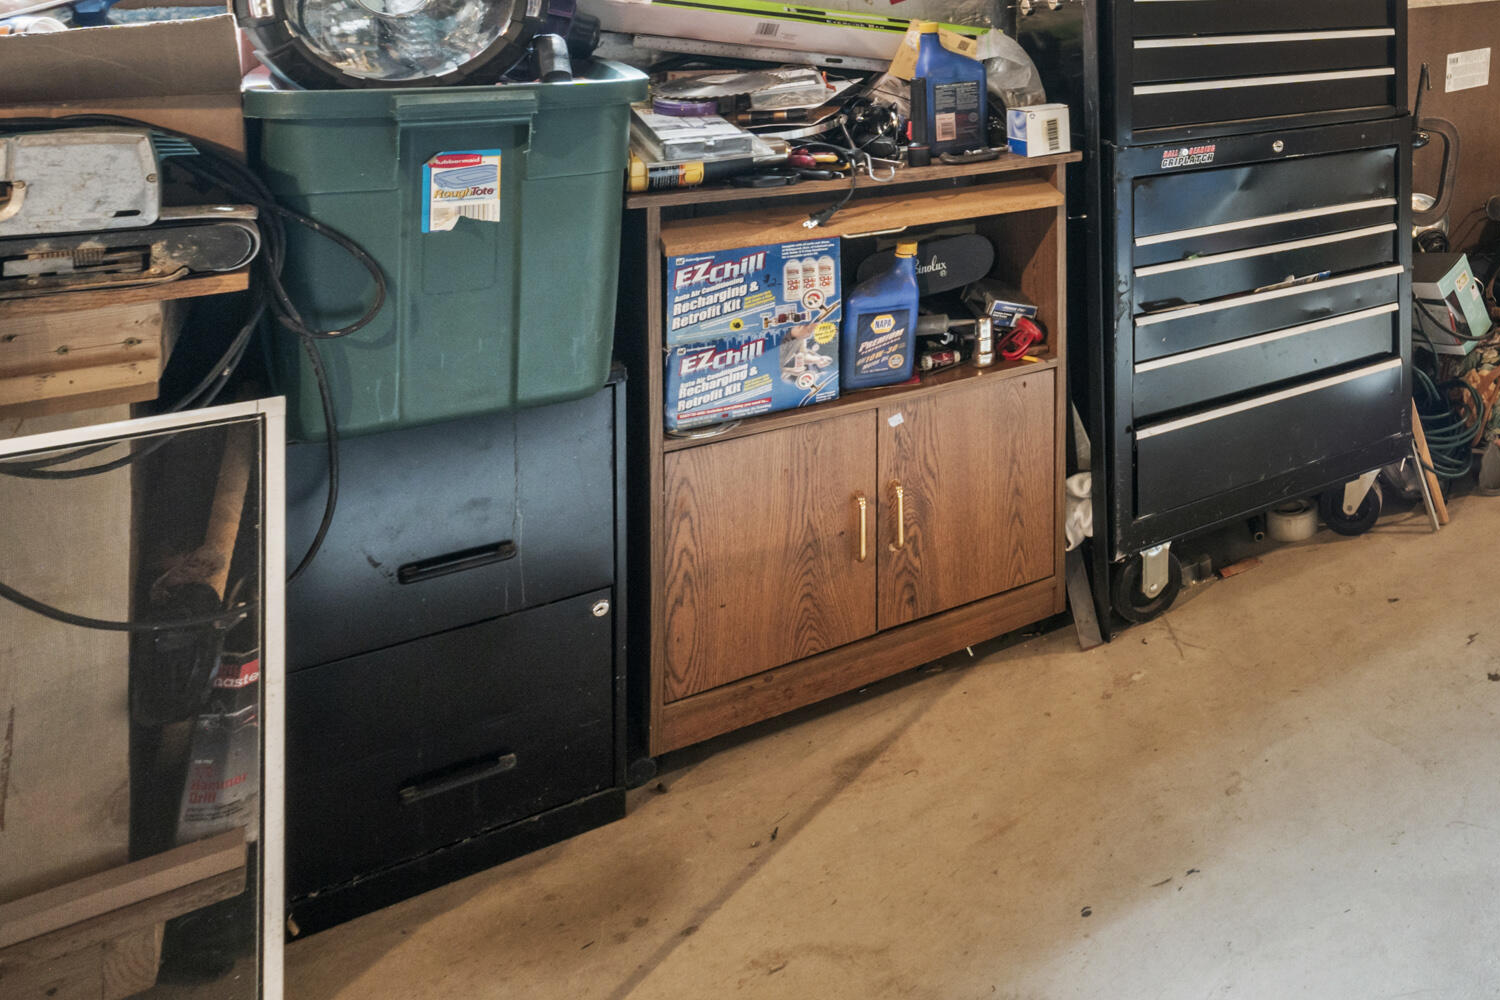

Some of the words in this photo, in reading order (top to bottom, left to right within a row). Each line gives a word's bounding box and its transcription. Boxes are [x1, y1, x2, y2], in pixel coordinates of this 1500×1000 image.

[673, 283, 748, 316] Recharging
[750, 281, 759, 292] &
[675, 294, 690, 302] Auto
[701, 277, 744, 294] Conditioning
[672, 304, 722, 331] Retrofit
[724, 299, 741, 314] Kit
[679, 369, 748, 399] Recharging
[750, 366, 758, 376] &
[706, 364, 748, 382] Conditioning
[677, 388, 722, 412] Retrofit
[725, 382, 742, 396] Kit
[213, 672, 260, 688] aste
